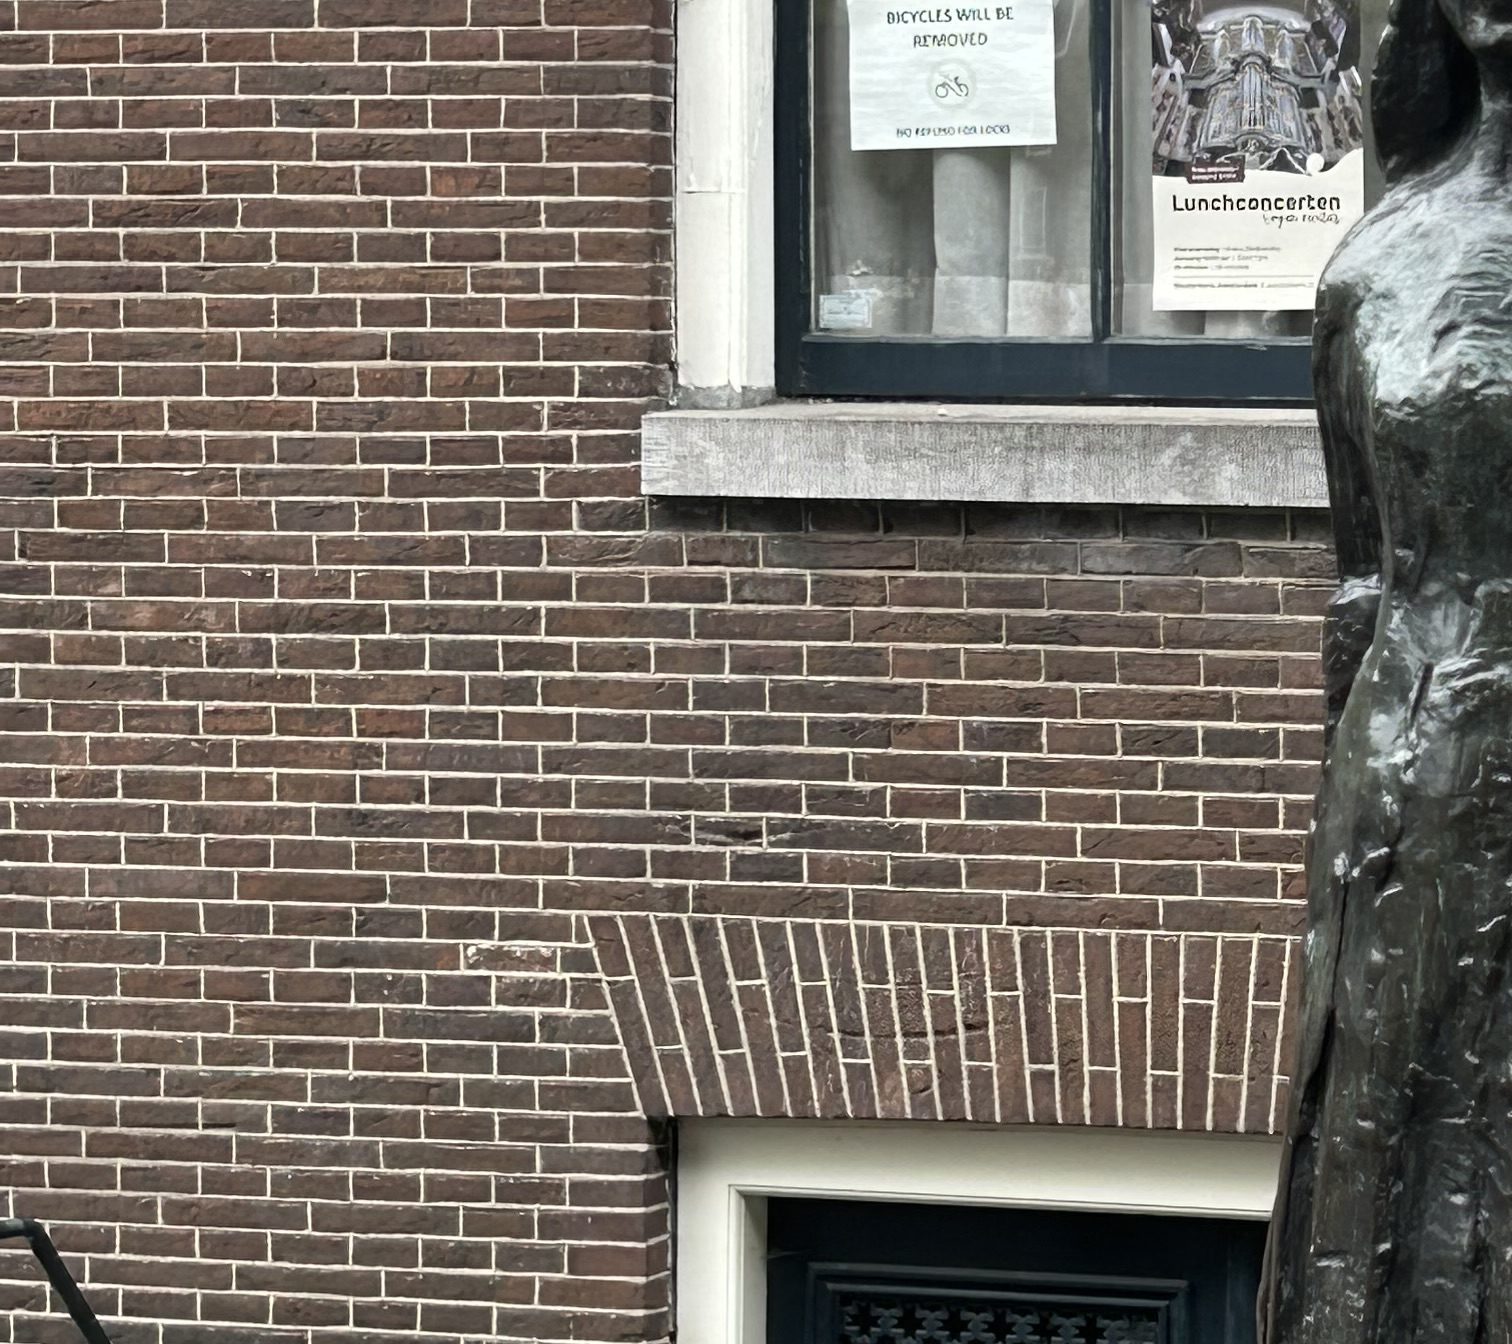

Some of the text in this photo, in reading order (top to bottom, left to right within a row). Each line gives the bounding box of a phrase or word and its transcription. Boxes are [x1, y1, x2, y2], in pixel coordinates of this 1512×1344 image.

[887, 6, 1014, 24] BICYCLES WILL BE
[913, 32, 988, 48] REMOVED
[1172, 194, 1341, 212] Lunchconcerten
